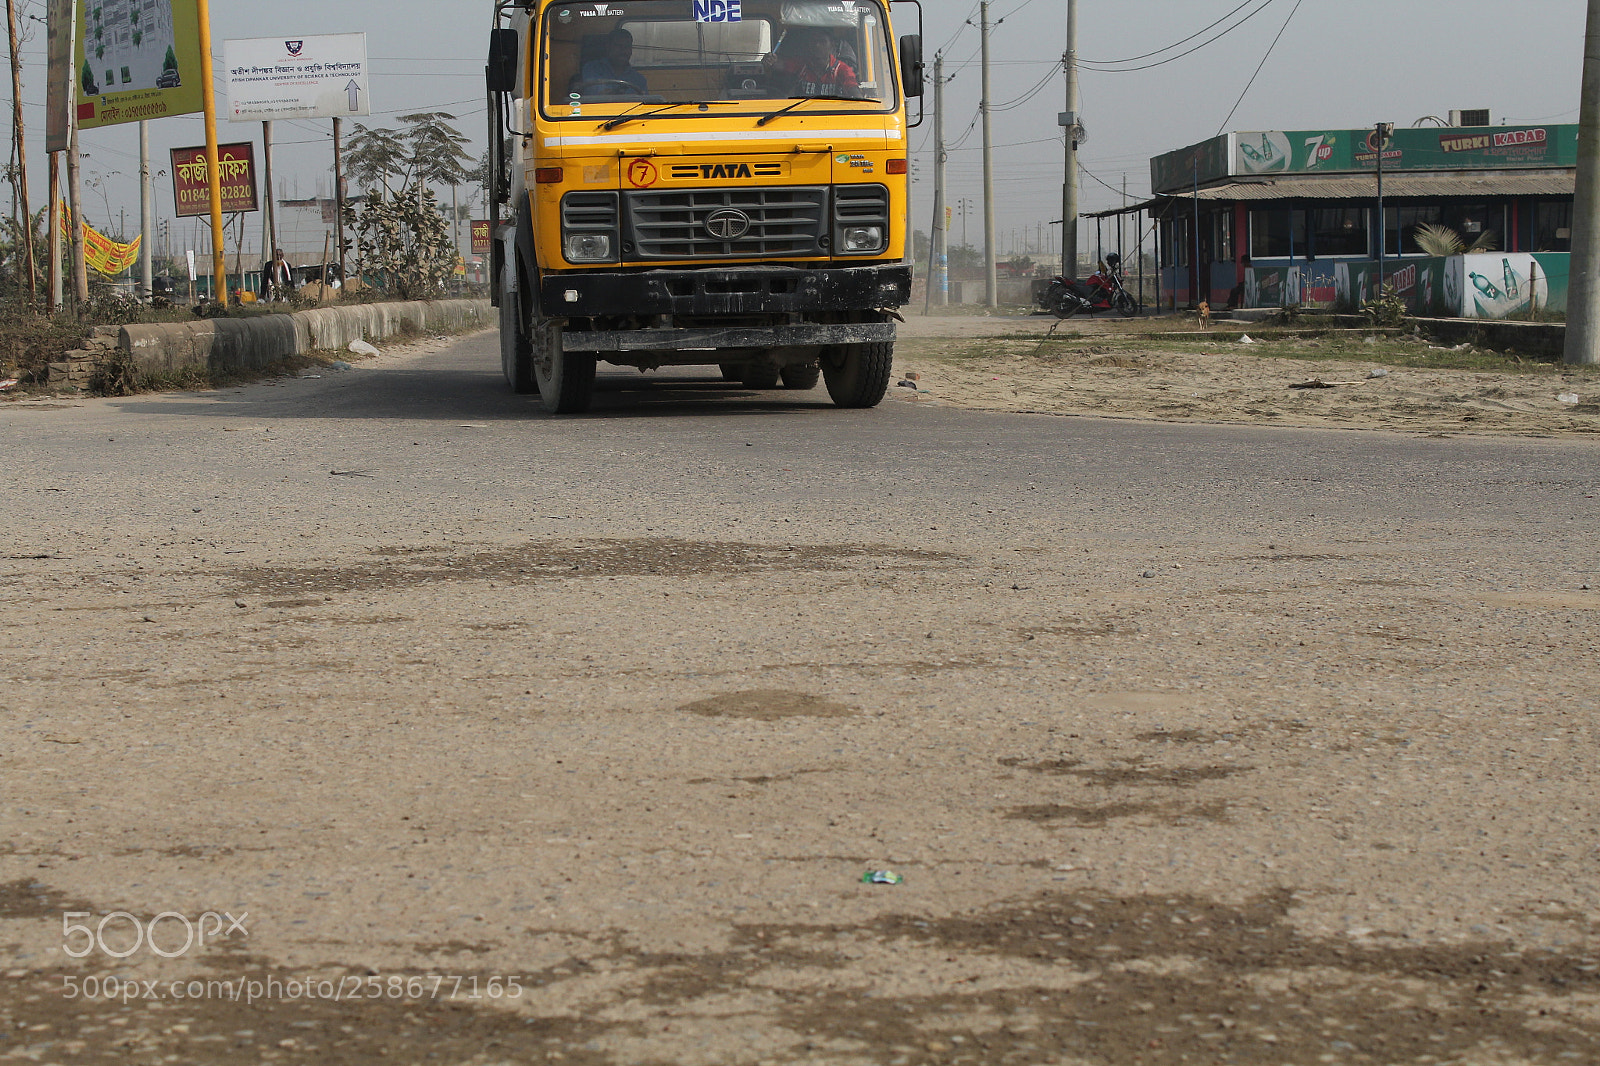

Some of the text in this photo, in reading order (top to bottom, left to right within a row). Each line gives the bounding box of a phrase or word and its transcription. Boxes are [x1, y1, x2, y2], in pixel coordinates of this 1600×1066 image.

[693, 0, 742, 22] NDE
[275, 65, 295, 73] বিজ্ঞান
[1441, 129, 1547, 152] TURKI KABAB
[177, 154, 209, 185] কাজী
[636, 165, 649, 182] 7
[700, 164, 752, 179] TATA
[473, 223, 489, 238] কাজী
